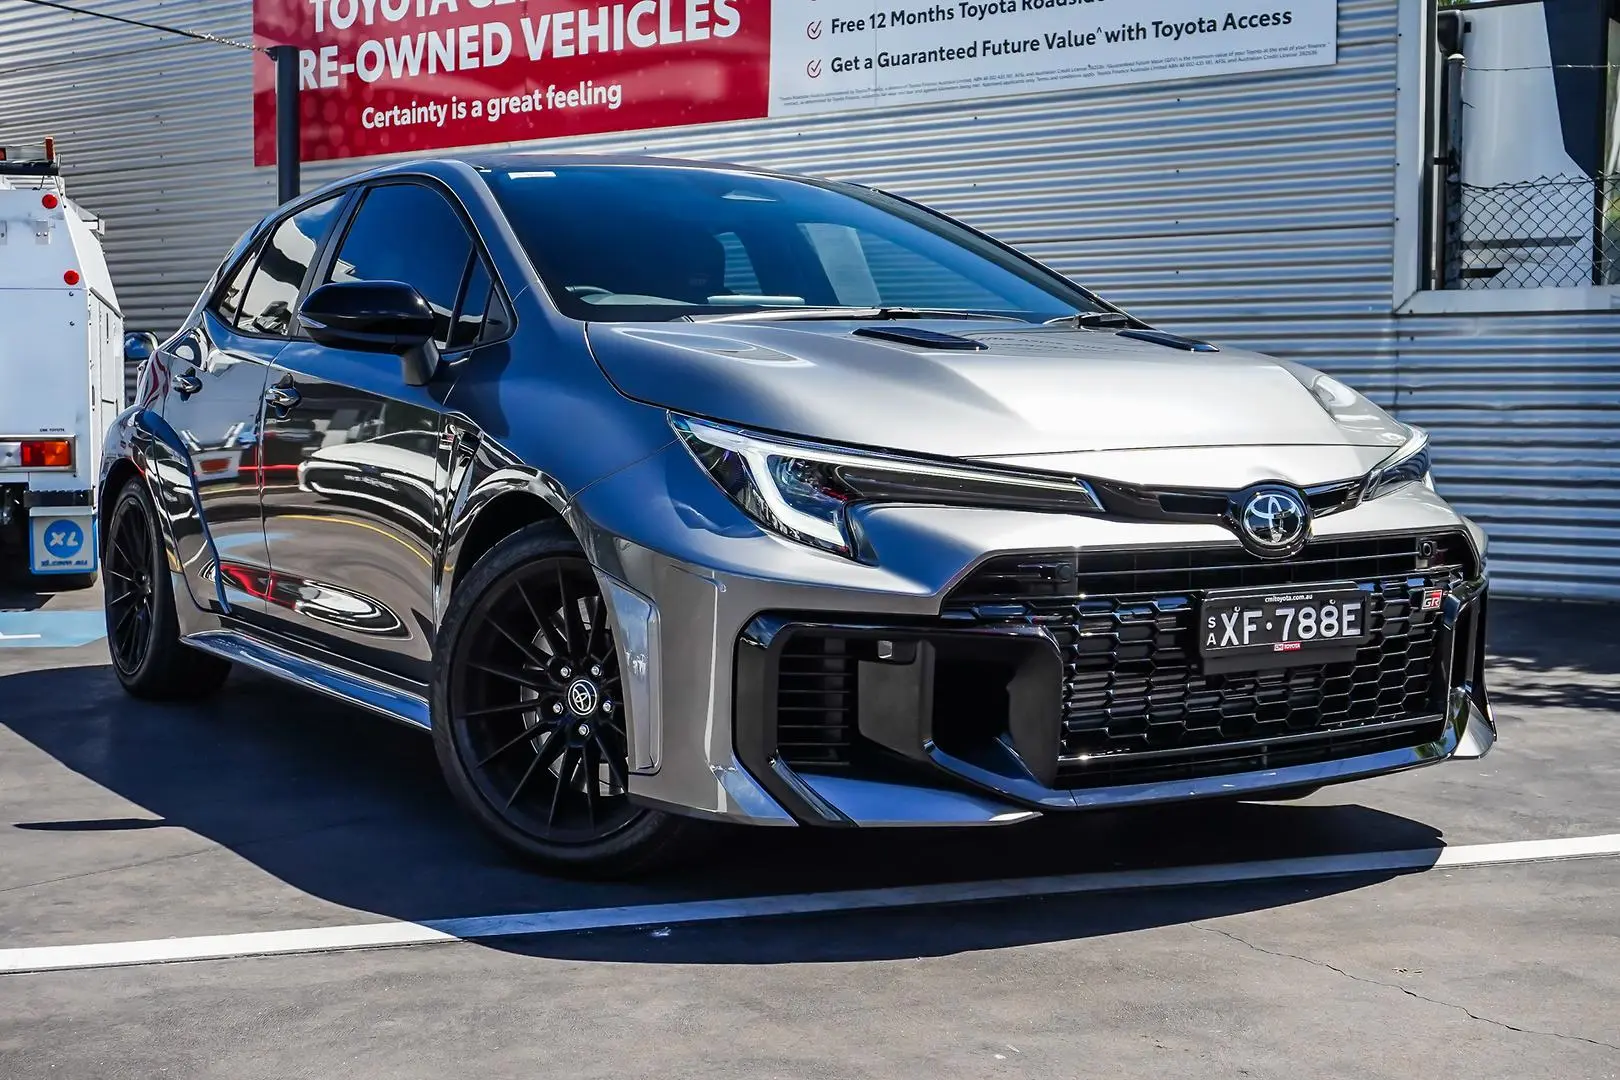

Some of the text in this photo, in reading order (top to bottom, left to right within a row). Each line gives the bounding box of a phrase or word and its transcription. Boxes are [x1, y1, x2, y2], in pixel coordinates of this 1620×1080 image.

[831, 18, 865, 34] Free
[869, 12, 886, 29] 12
[891, 5, 955, 27] Months
[959, 0, 1017, 21] Toyota
[275, 0, 742, 94] RE-OWNED VEHICLES
[831, 55, 861, 73] Get
[864, 58, 873, 70] a
[877, 41, 978, 68] Guaranteed
[982, 38, 1040, 57] Future
[1105, 22, 1147, 43] with
[1152, 17, 1217, 40] Toyota
[1222, 10, 1292, 31] Access
[361, 80, 622, 129] Certainty is a great feeling
[50, 531, 78, 547] XL
[1264, 593, 1313, 603] cmitoyota.com.au
[1425, 597, 1440, 607] GR
